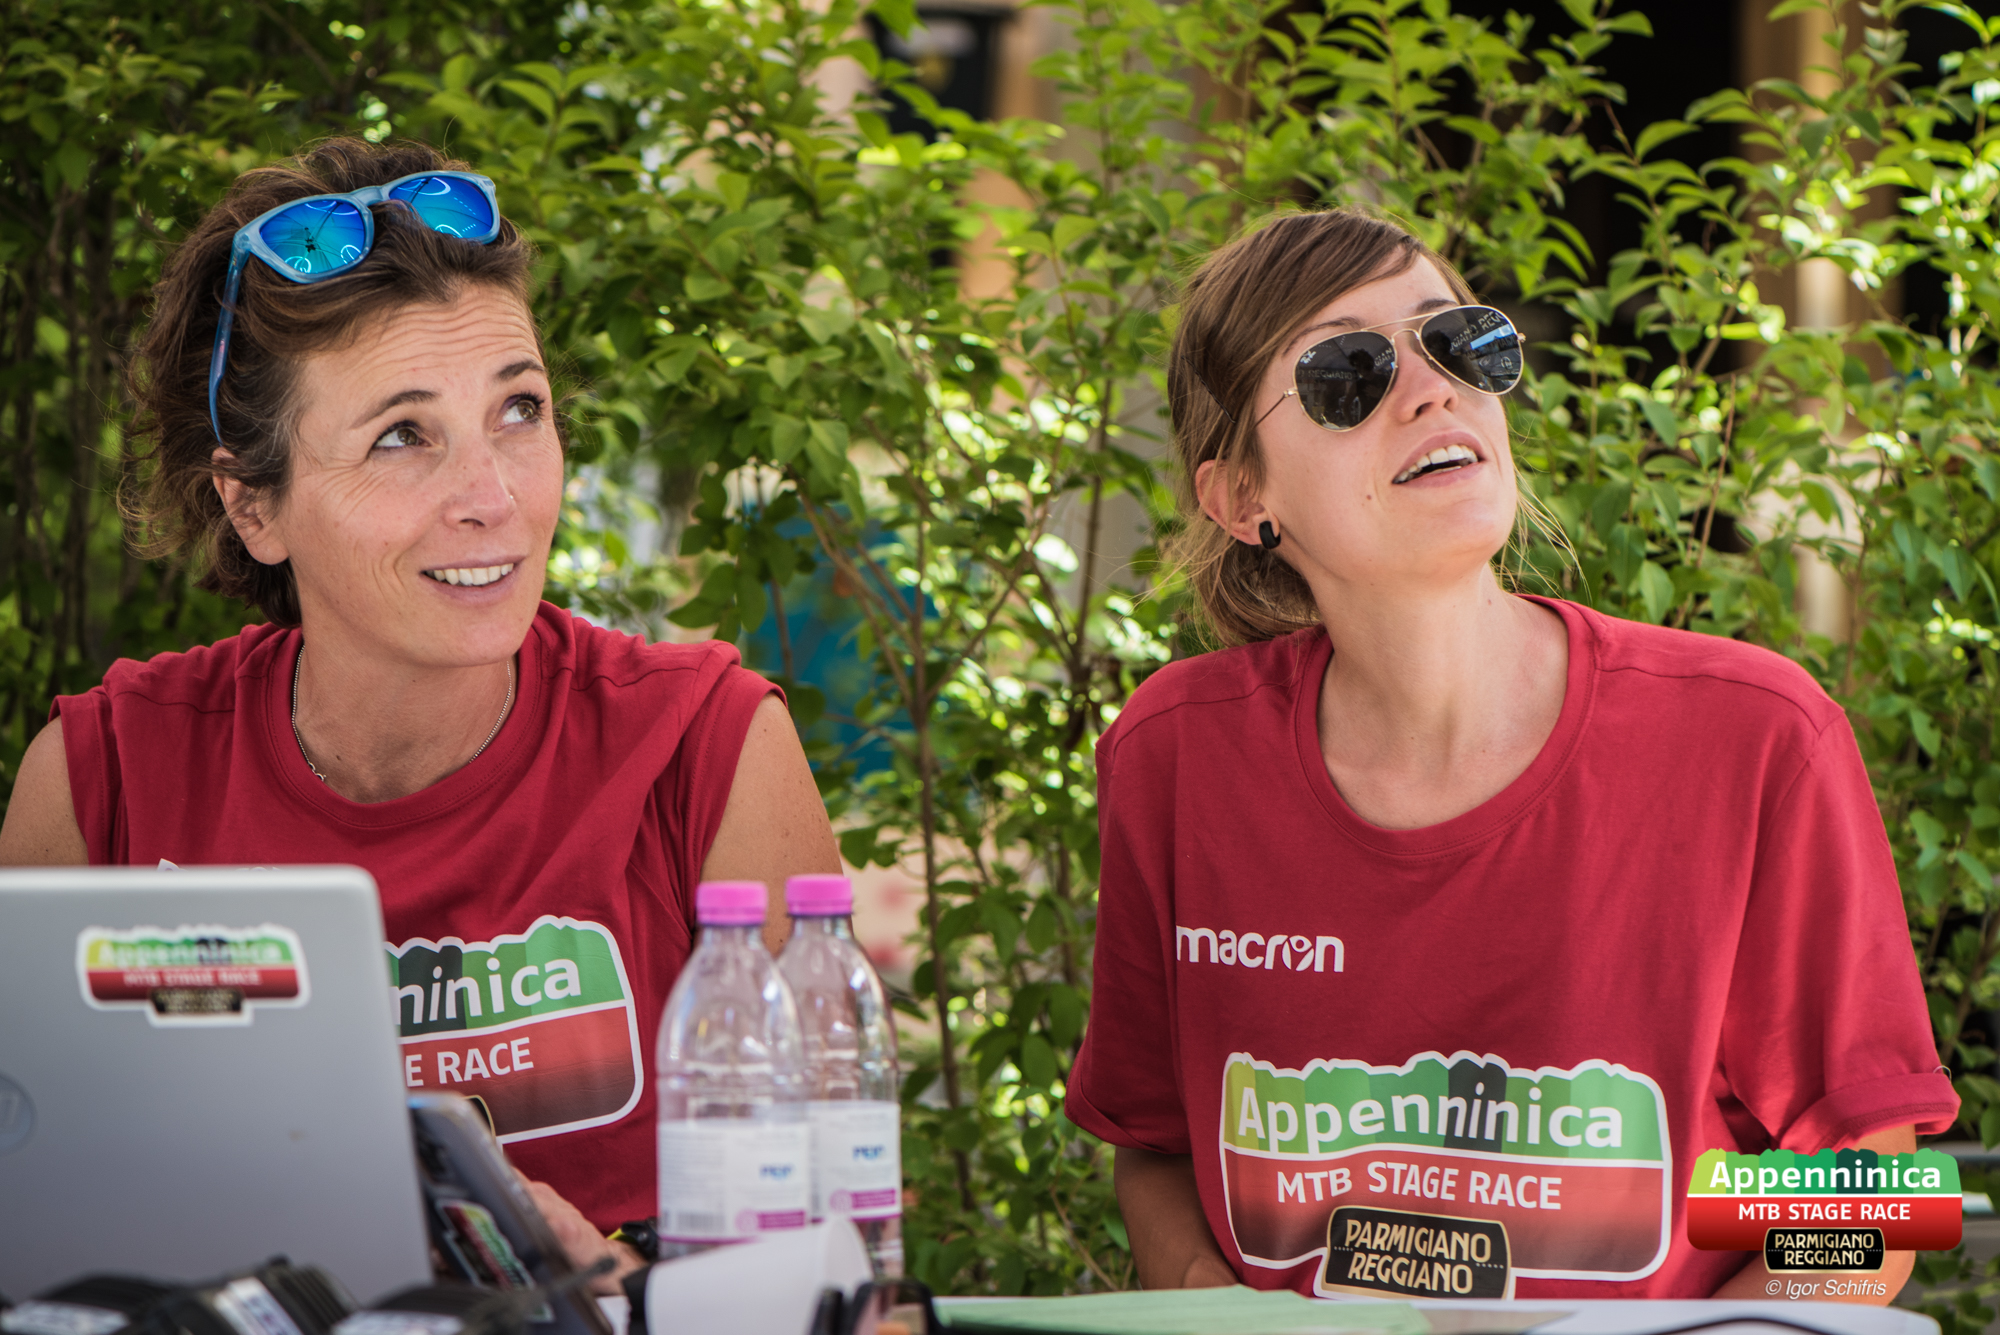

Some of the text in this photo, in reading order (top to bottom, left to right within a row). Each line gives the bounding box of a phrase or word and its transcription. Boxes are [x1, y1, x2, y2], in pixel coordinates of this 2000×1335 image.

[1176, 925, 1345, 973] macron
[390, 957, 581, 1025] ninica
[437, 1037, 534, 1084] RACE
[1238, 1081, 1622, 1157] Appenninica
[1277, 1161, 1562, 1210] MTB STAGE RACE
[1344, 1219, 1491, 1263] PARMIGIANO
[1347, 1252, 1473, 1294] REGGIANO
